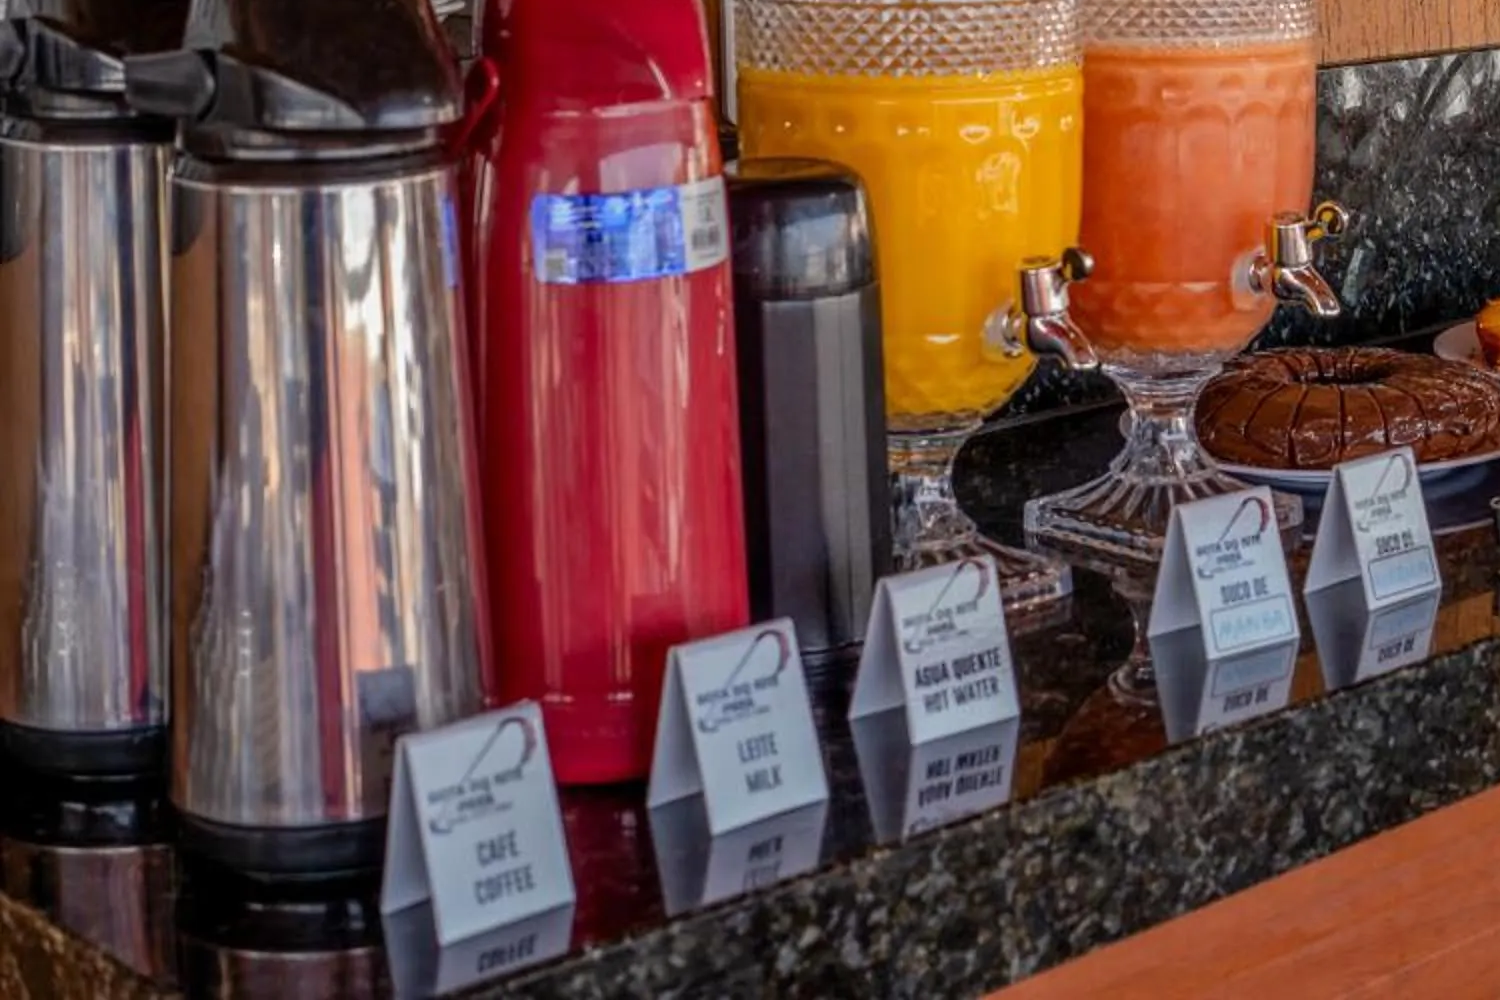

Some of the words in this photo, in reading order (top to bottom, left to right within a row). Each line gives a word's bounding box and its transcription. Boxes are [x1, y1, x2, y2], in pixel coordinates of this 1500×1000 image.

[953, 676, 1000, 707] WATER
[738, 733, 779, 764] LEITE
[745, 765, 782, 793] MILK
[475, 864, 537, 905] COFFEE
